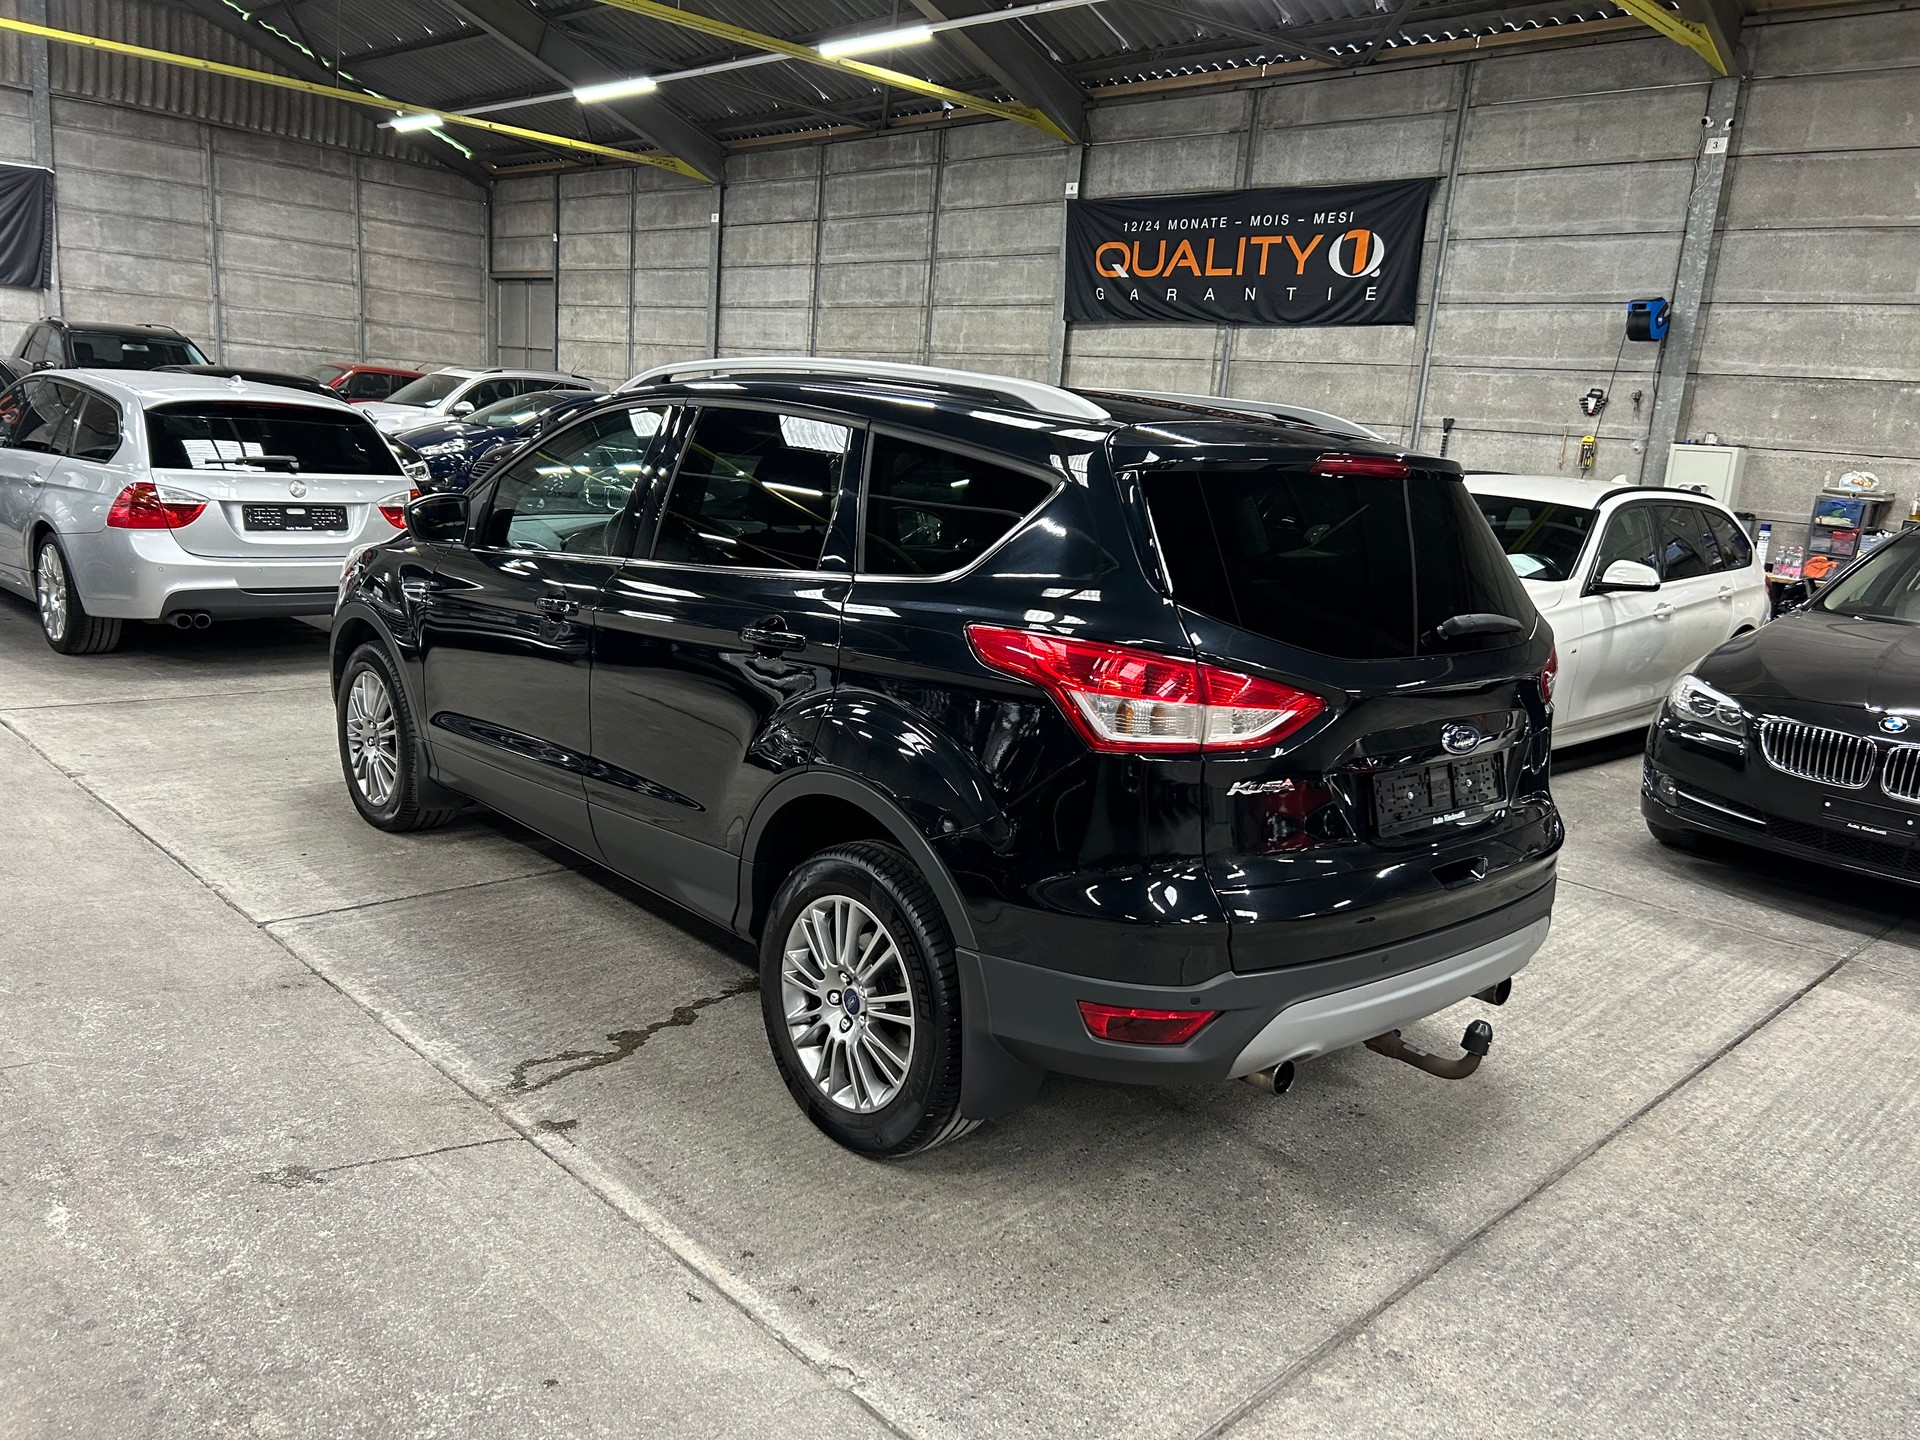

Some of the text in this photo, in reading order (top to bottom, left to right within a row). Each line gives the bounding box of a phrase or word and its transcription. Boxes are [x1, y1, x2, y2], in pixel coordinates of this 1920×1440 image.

[1712, 141, 1718, 149] 3
[1123, 220, 1160, 232] 12/24
[1167, 217, 1228, 231] MONATE
[1250, 213, 1290, 227] MOIS
[1313, 211, 1354, 225] MESI
[1096, 234, 1325, 278] QUALITY
[1096, 286, 1377, 301] GARANTIE
[1432, 816, 1444, 825] Auto
[891, 919, 931, 1018] MICHELIN
